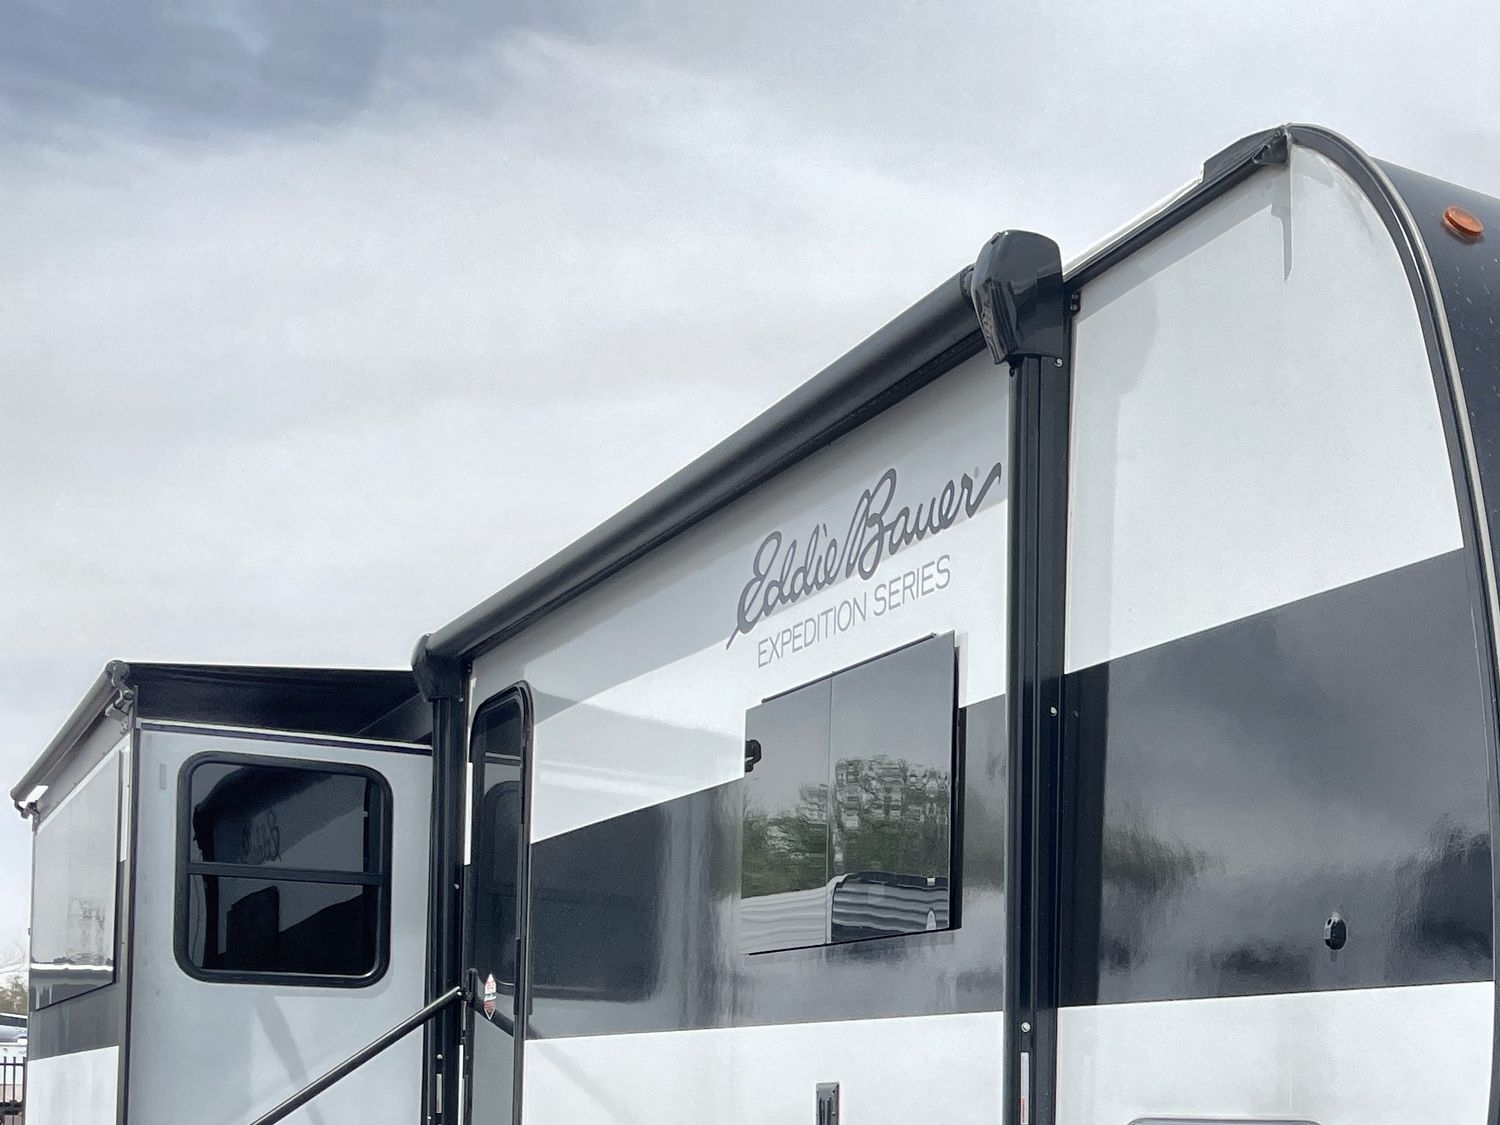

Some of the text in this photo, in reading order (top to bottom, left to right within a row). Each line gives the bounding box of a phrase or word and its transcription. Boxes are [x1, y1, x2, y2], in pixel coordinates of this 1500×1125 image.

[726, 462, 1002, 650] Eddie Bauer
[757, 554, 951, 669] EXPEDITION SERIES
